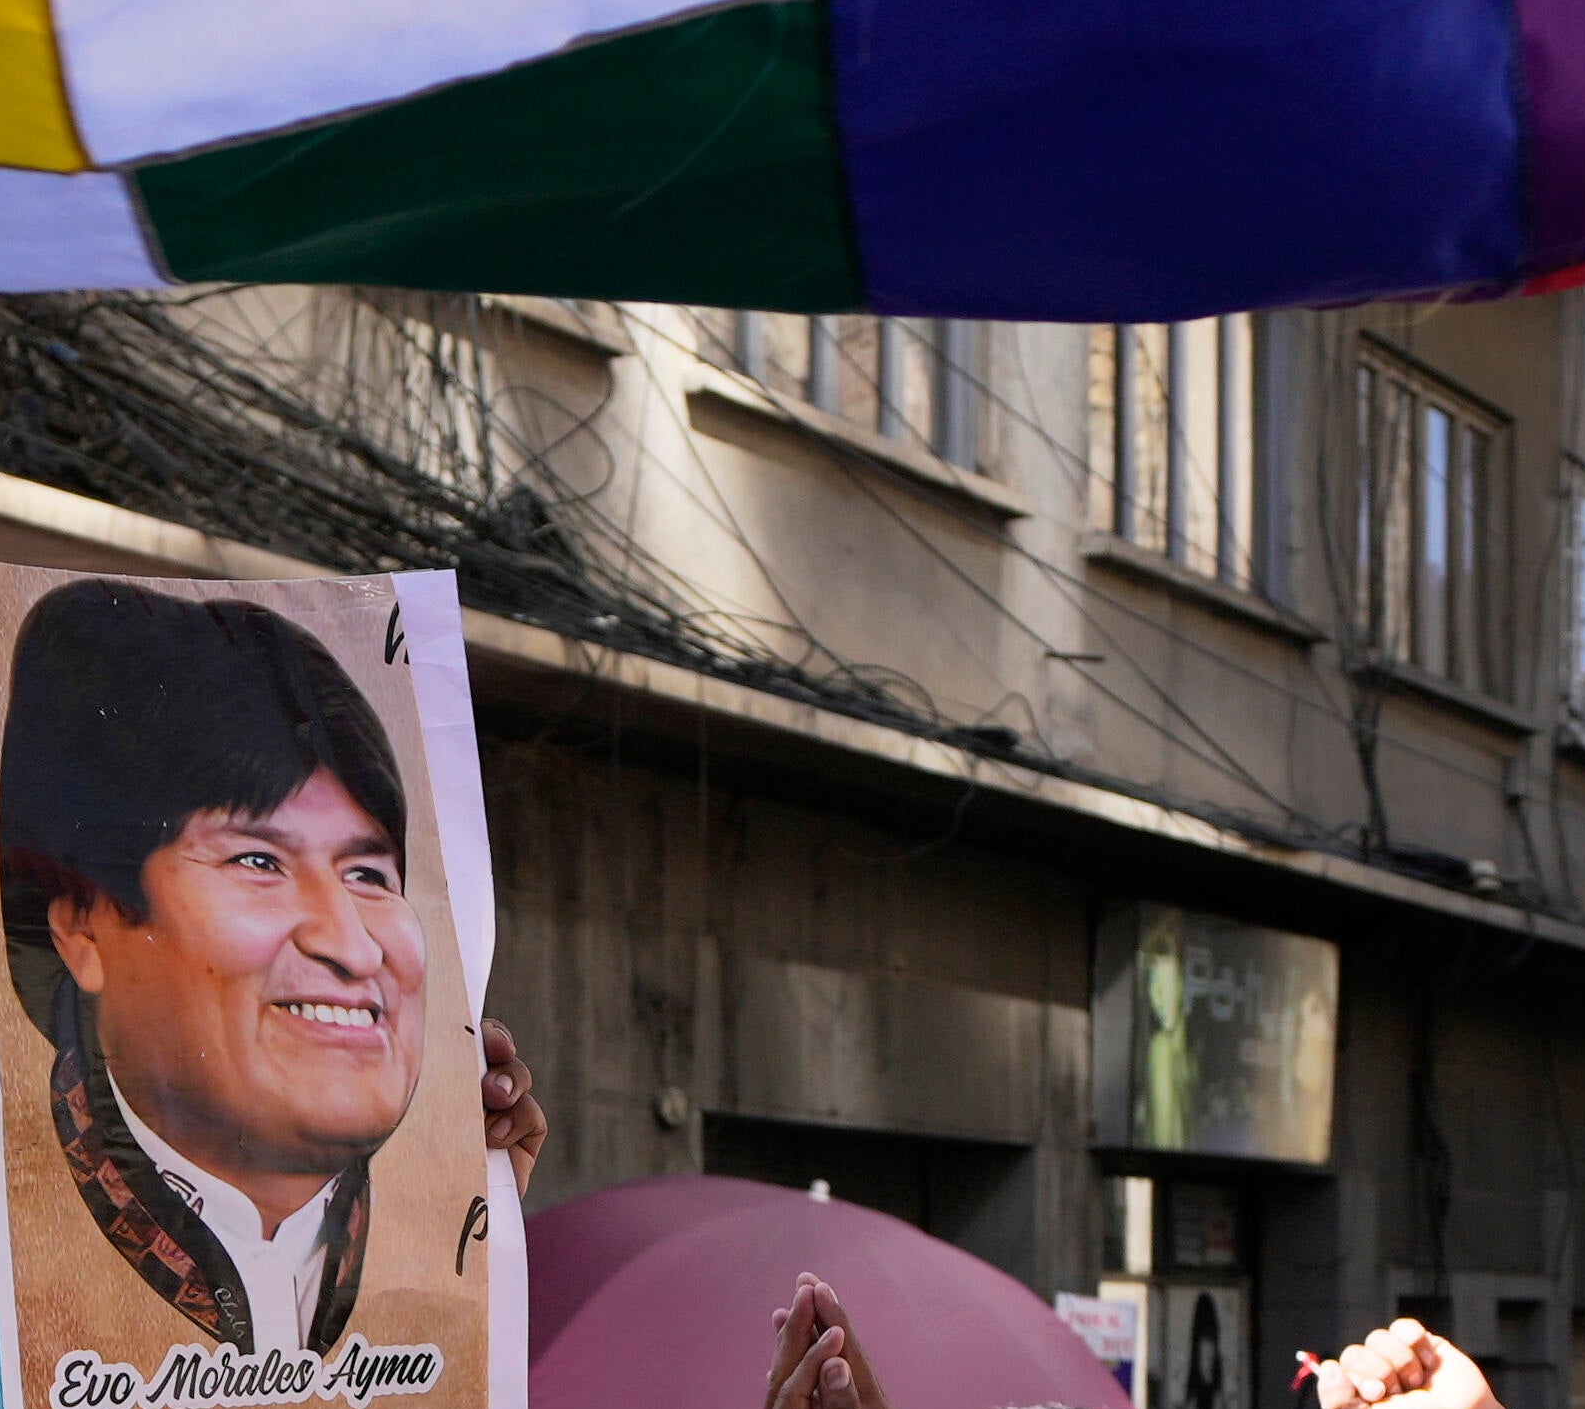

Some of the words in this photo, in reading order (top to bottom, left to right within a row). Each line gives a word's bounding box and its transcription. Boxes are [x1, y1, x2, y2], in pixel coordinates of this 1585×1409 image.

[59, 1359, 135, 1408] Evo
[146, 1347, 316, 1404] Morales
[325, 1341, 437, 1401] Ayma
